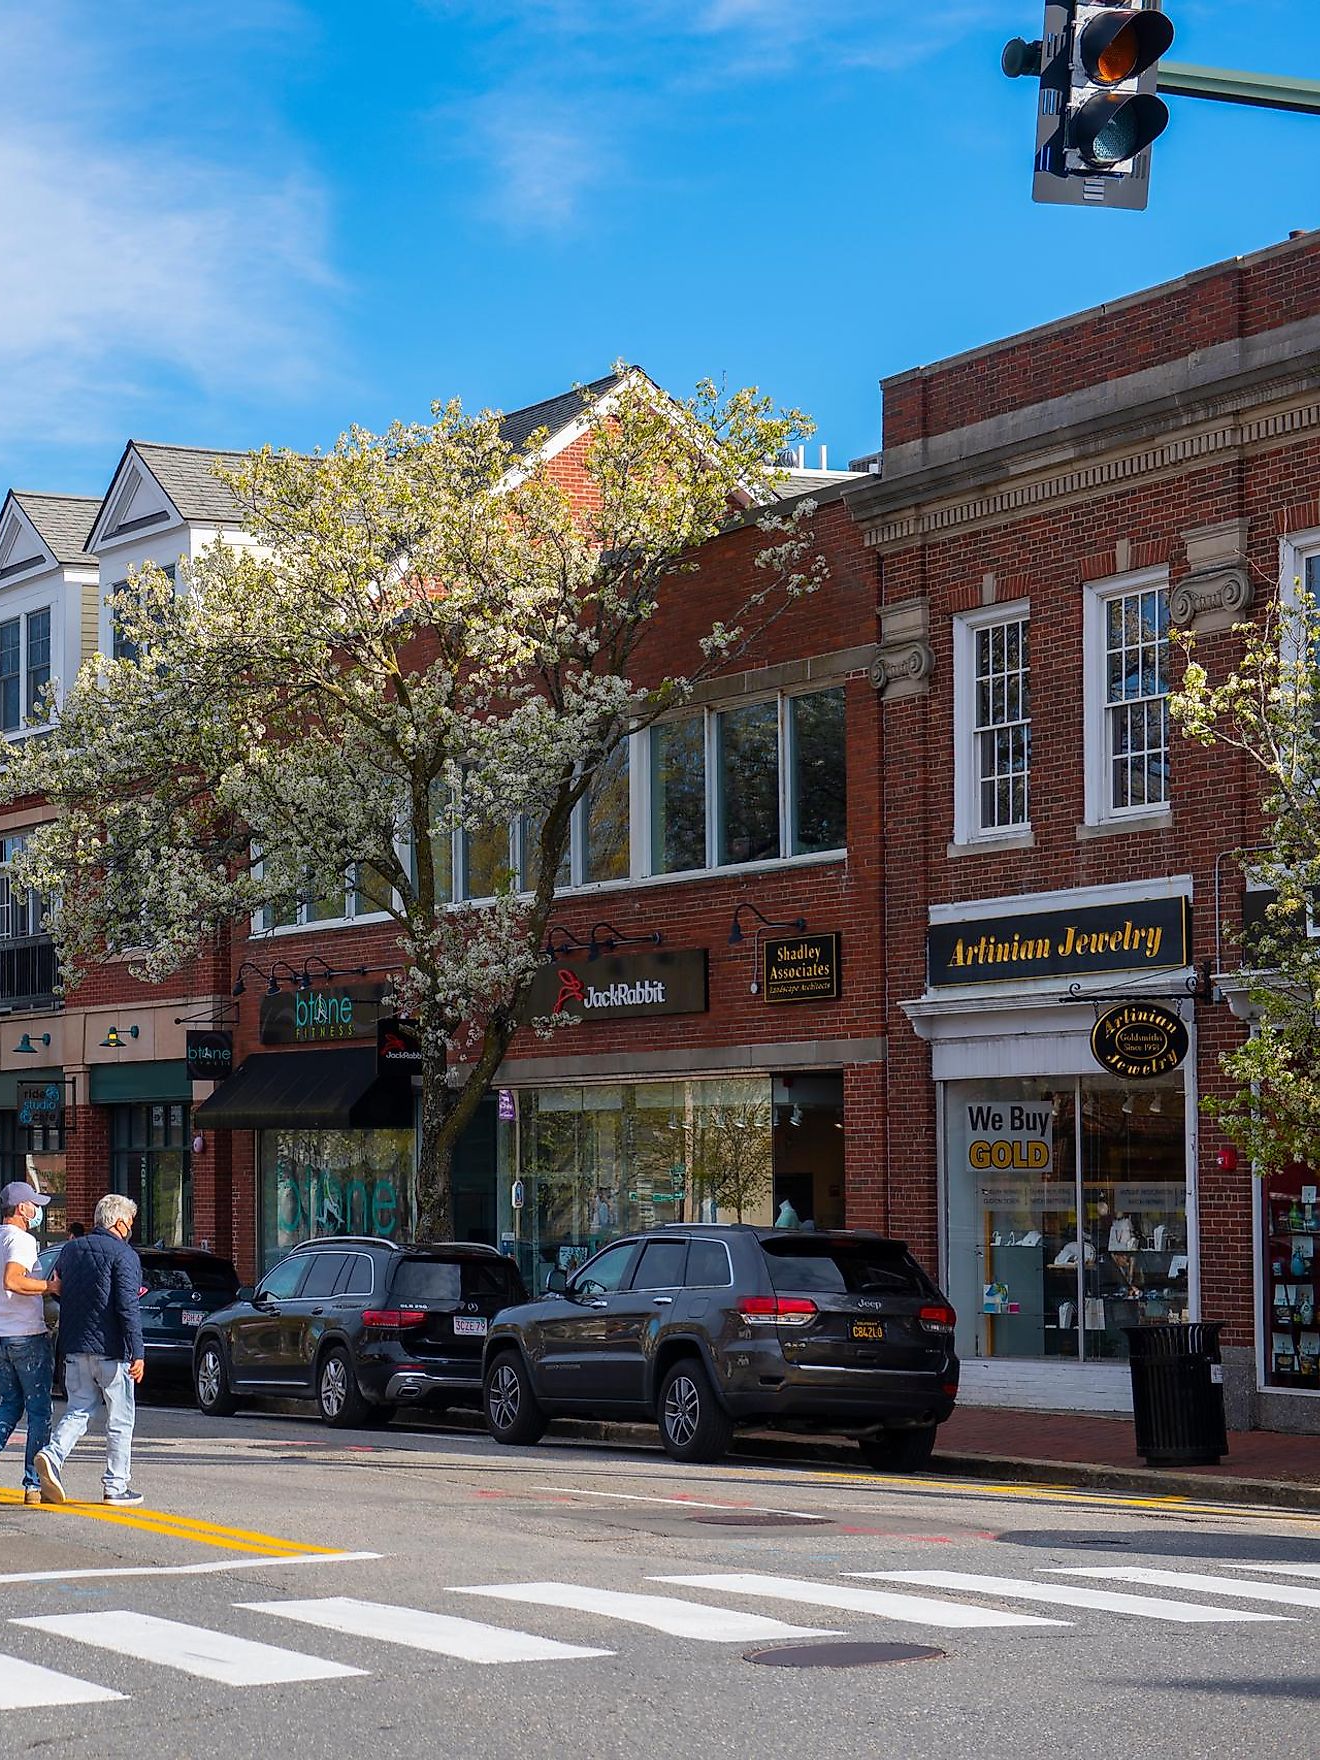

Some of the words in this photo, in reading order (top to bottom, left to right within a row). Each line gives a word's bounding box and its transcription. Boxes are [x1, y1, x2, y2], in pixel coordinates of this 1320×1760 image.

[947, 933, 1050, 967] Artinian
[1058, 920, 1163, 958] Jewelry
[777, 944, 820, 962] Shadley
[770, 963, 830, 979] Associates
[584, 981, 666, 1009] JackRabbit
[769, 984, 800, 994] Landscape
[801, 981, 831, 991] Architects
[296, 992, 352, 1027] btone
[296, 1025, 353, 1038] FITNESS
[1106, 1008, 1177, 1039] Artinian
[1120, 1033, 1162, 1042] Goldsmiths
[1124, 1043, 1142, 1051] Since
[1106, 1049, 1178, 1074] Jewelry
[24, 1088, 47, 1099] ride
[24, 1099, 57, 1110] studio
[968, 1106, 1003, 1131] We
[1011, 1106, 1050, 1137] Buy
[969, 1140, 1049, 1169] GOLD
[858, 1298, 882, 1310] Jeep
